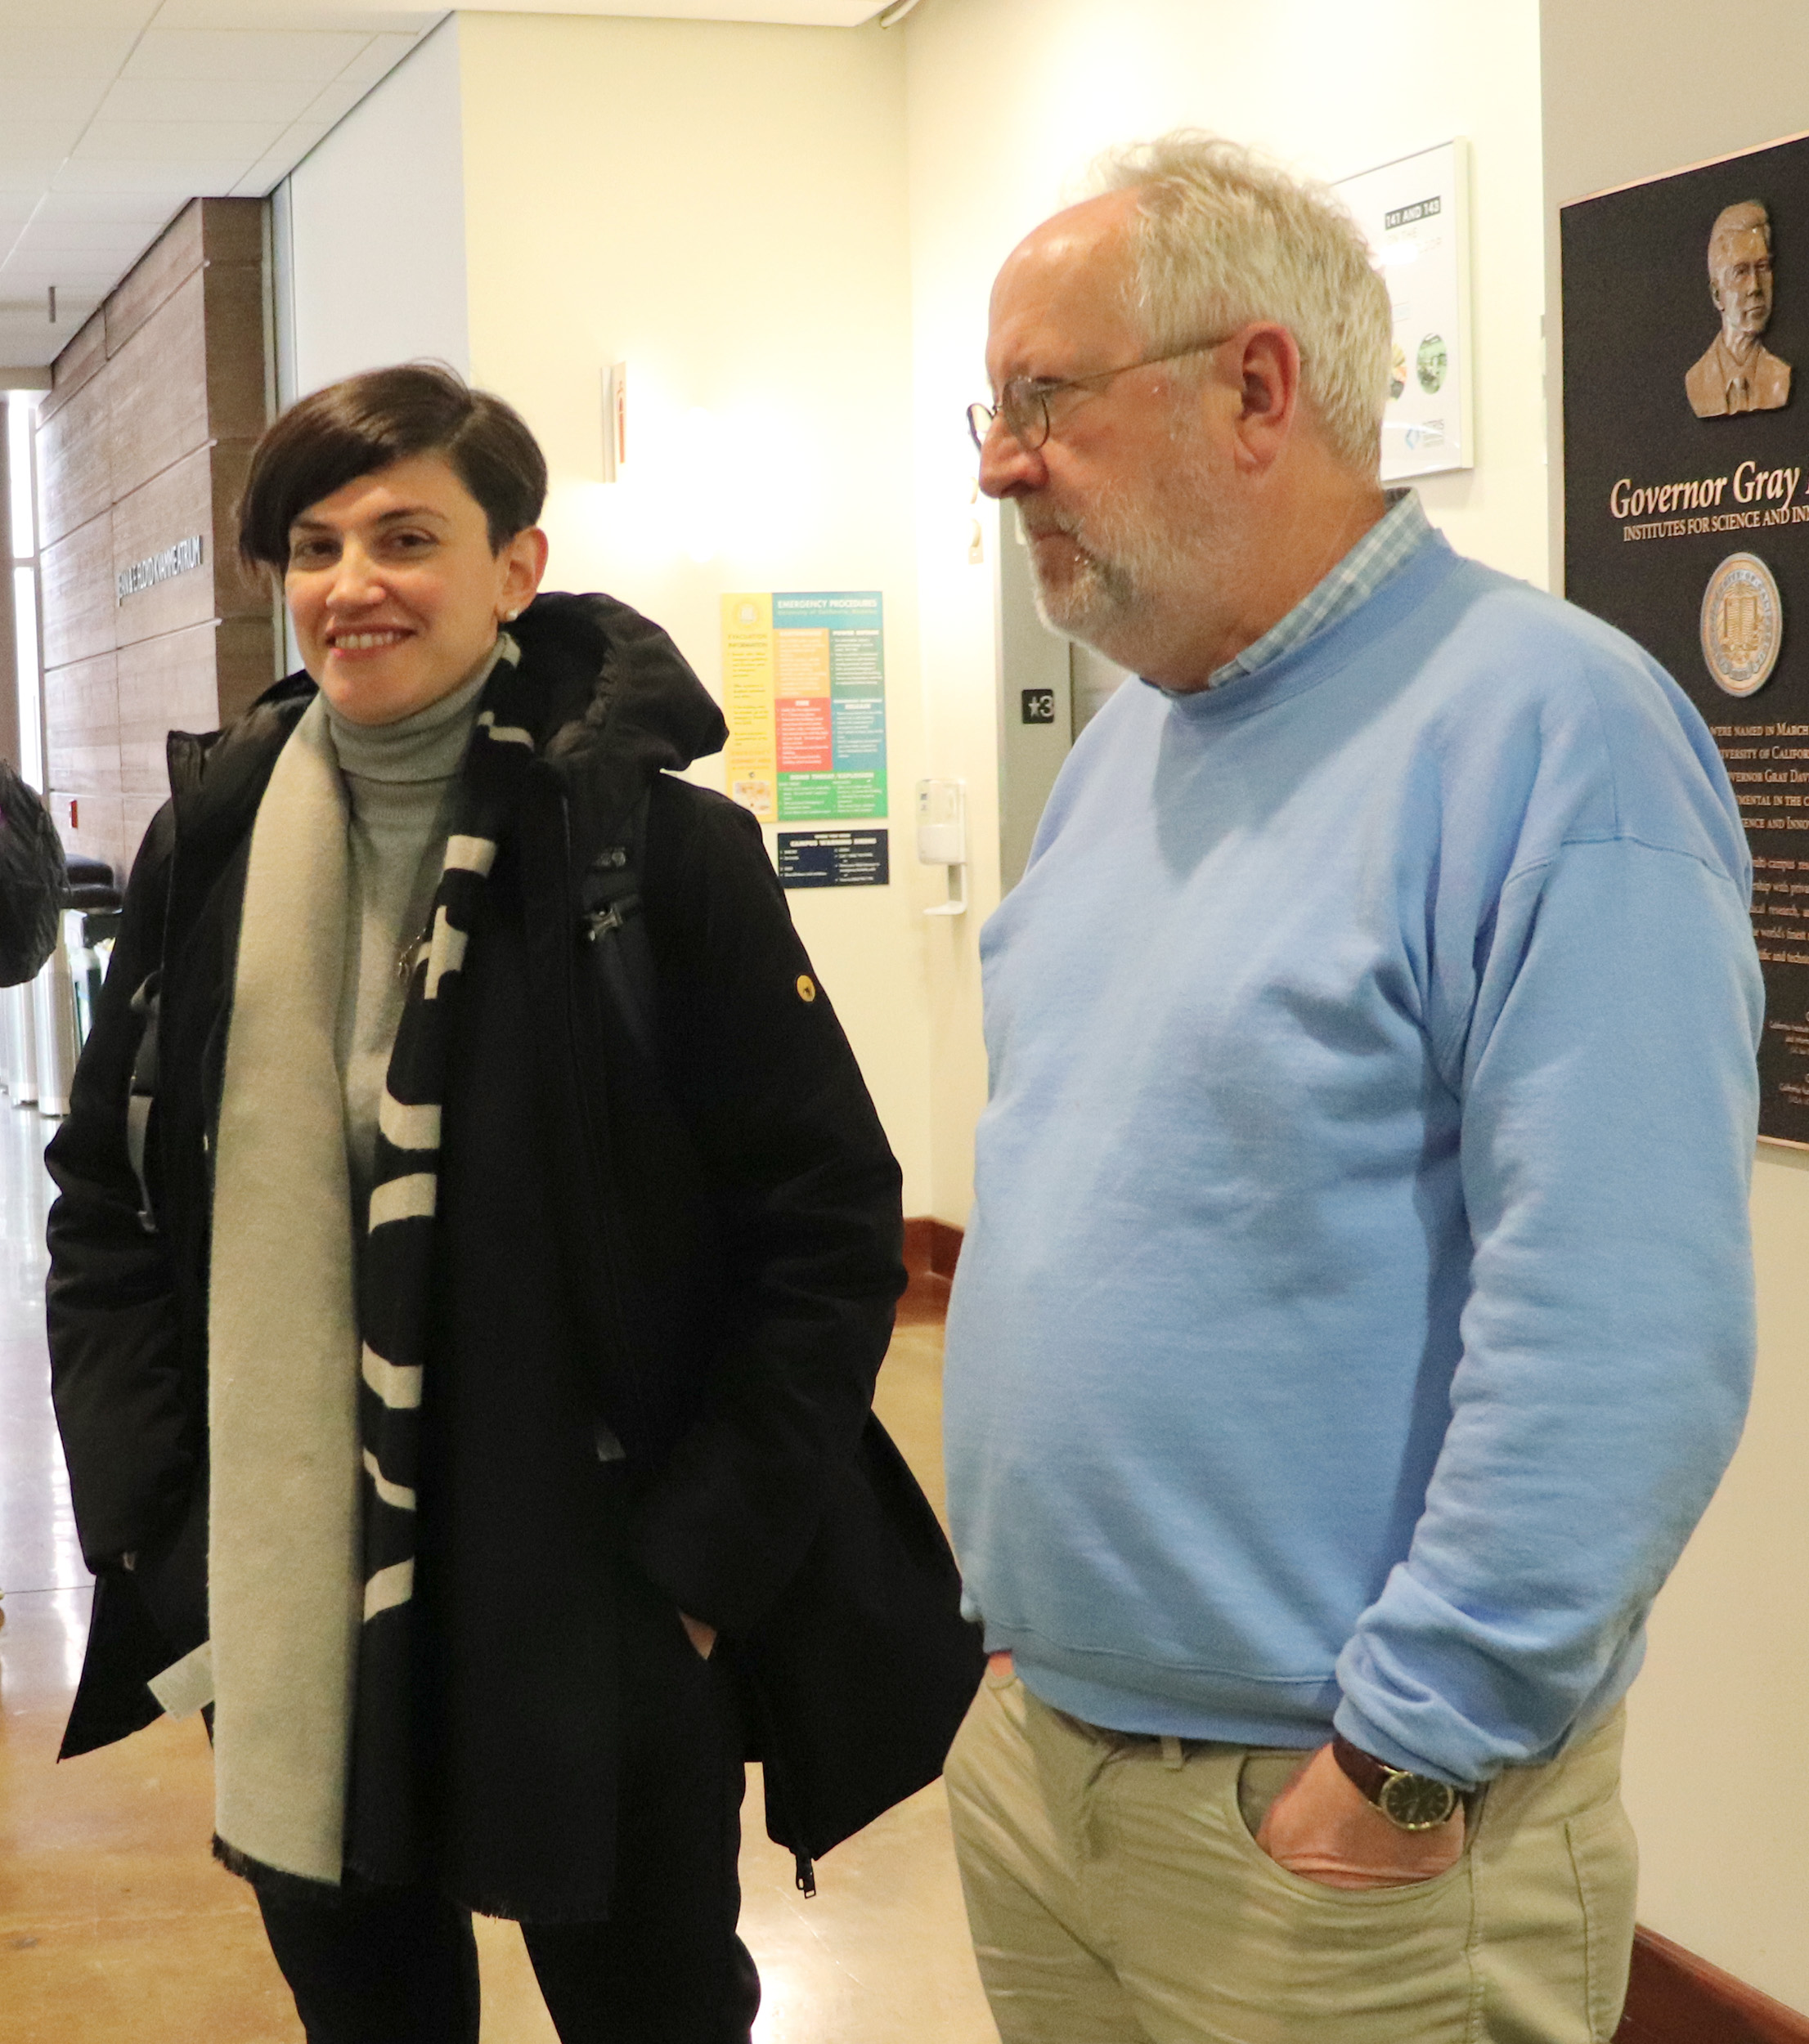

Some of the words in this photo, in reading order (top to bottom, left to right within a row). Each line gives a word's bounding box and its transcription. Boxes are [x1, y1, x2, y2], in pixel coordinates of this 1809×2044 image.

[1386, 212, 1400, 228] 141
[1402, 204, 1422, 223] AND
[1609, 478, 1728, 519] Governor
[1733, 460, 1800, 510] Gray
[1623, 518, 1686, 542] INSTITUTES
[1687, 517, 1710, 535] FOR
[1711, 511, 1760, 532] SCIENCE
[1762, 507, 1790, 527] AND
[777, 599, 828, 609] EMERGENCY
[1734, 726, 1763, 736] NAMED
[1765, 726, 1775, 736] IN
[1773, 796, 1783, 805] IN
[1784, 796, 1802, 806] THE
[1766, 818, 1784, 828] AND
